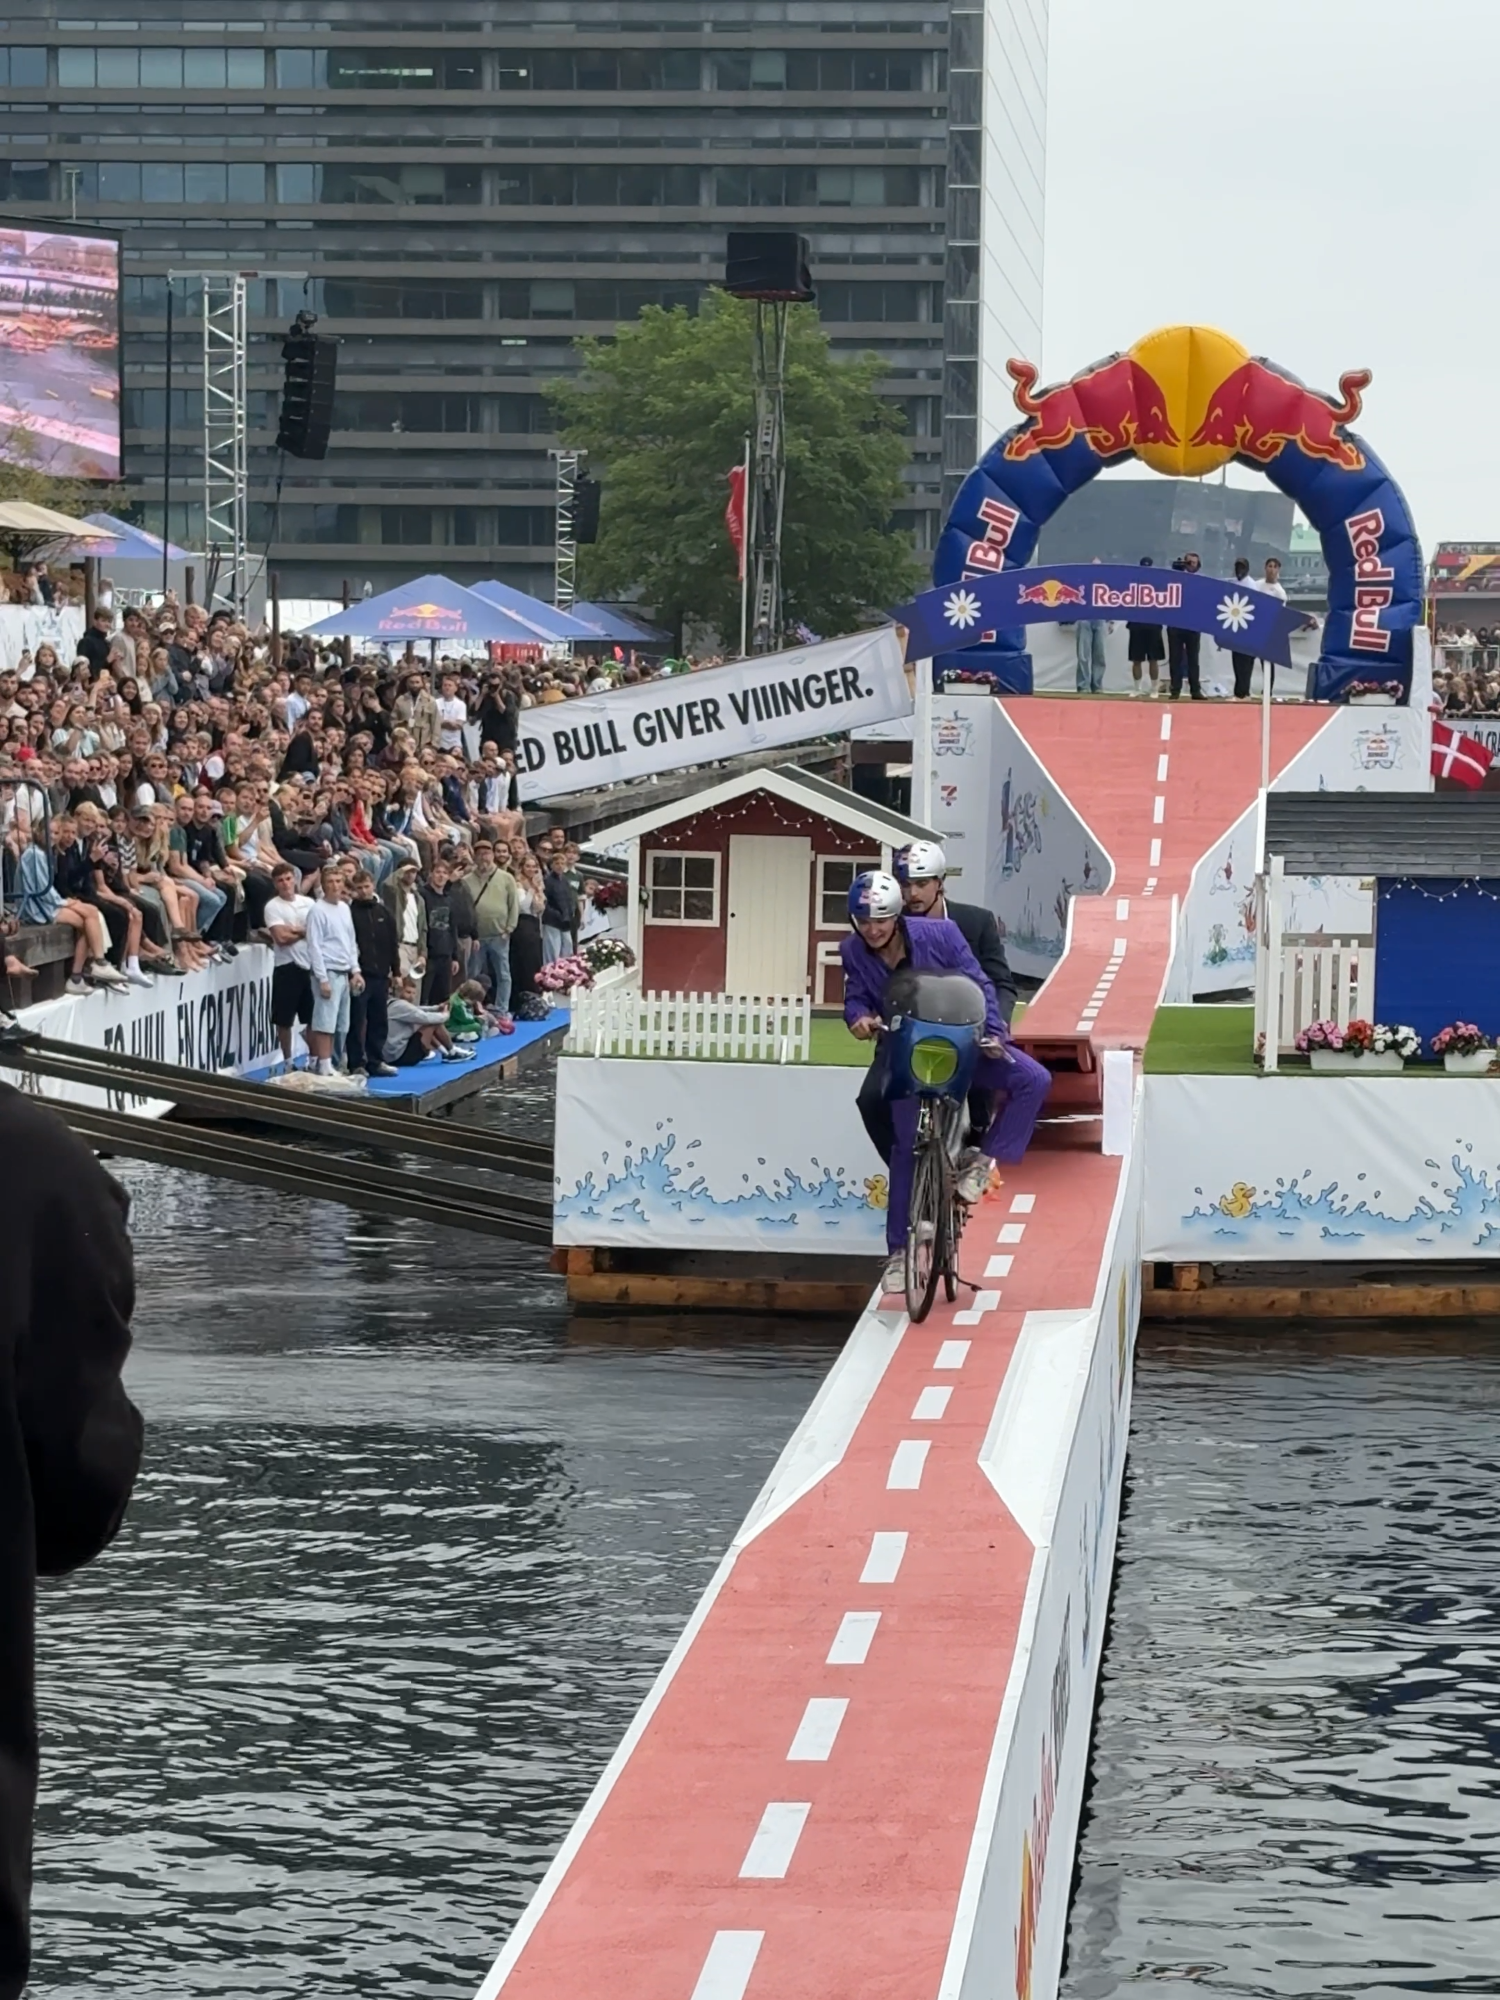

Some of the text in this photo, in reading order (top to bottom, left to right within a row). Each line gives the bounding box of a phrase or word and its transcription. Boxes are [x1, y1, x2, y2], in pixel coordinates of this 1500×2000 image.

[966, 497, 1020, 573] Bull
[1092, 583, 1182, 607] Red Bull
[1345, 508, 1394, 652] Red Bull
[378, 618, 468, 633] Red Bull
[515, 666, 874, 775] ED BULL GIVER VIIINGER.
[199, 983, 246, 1073] CRAZY
[248, 976, 280, 1061] BAN
